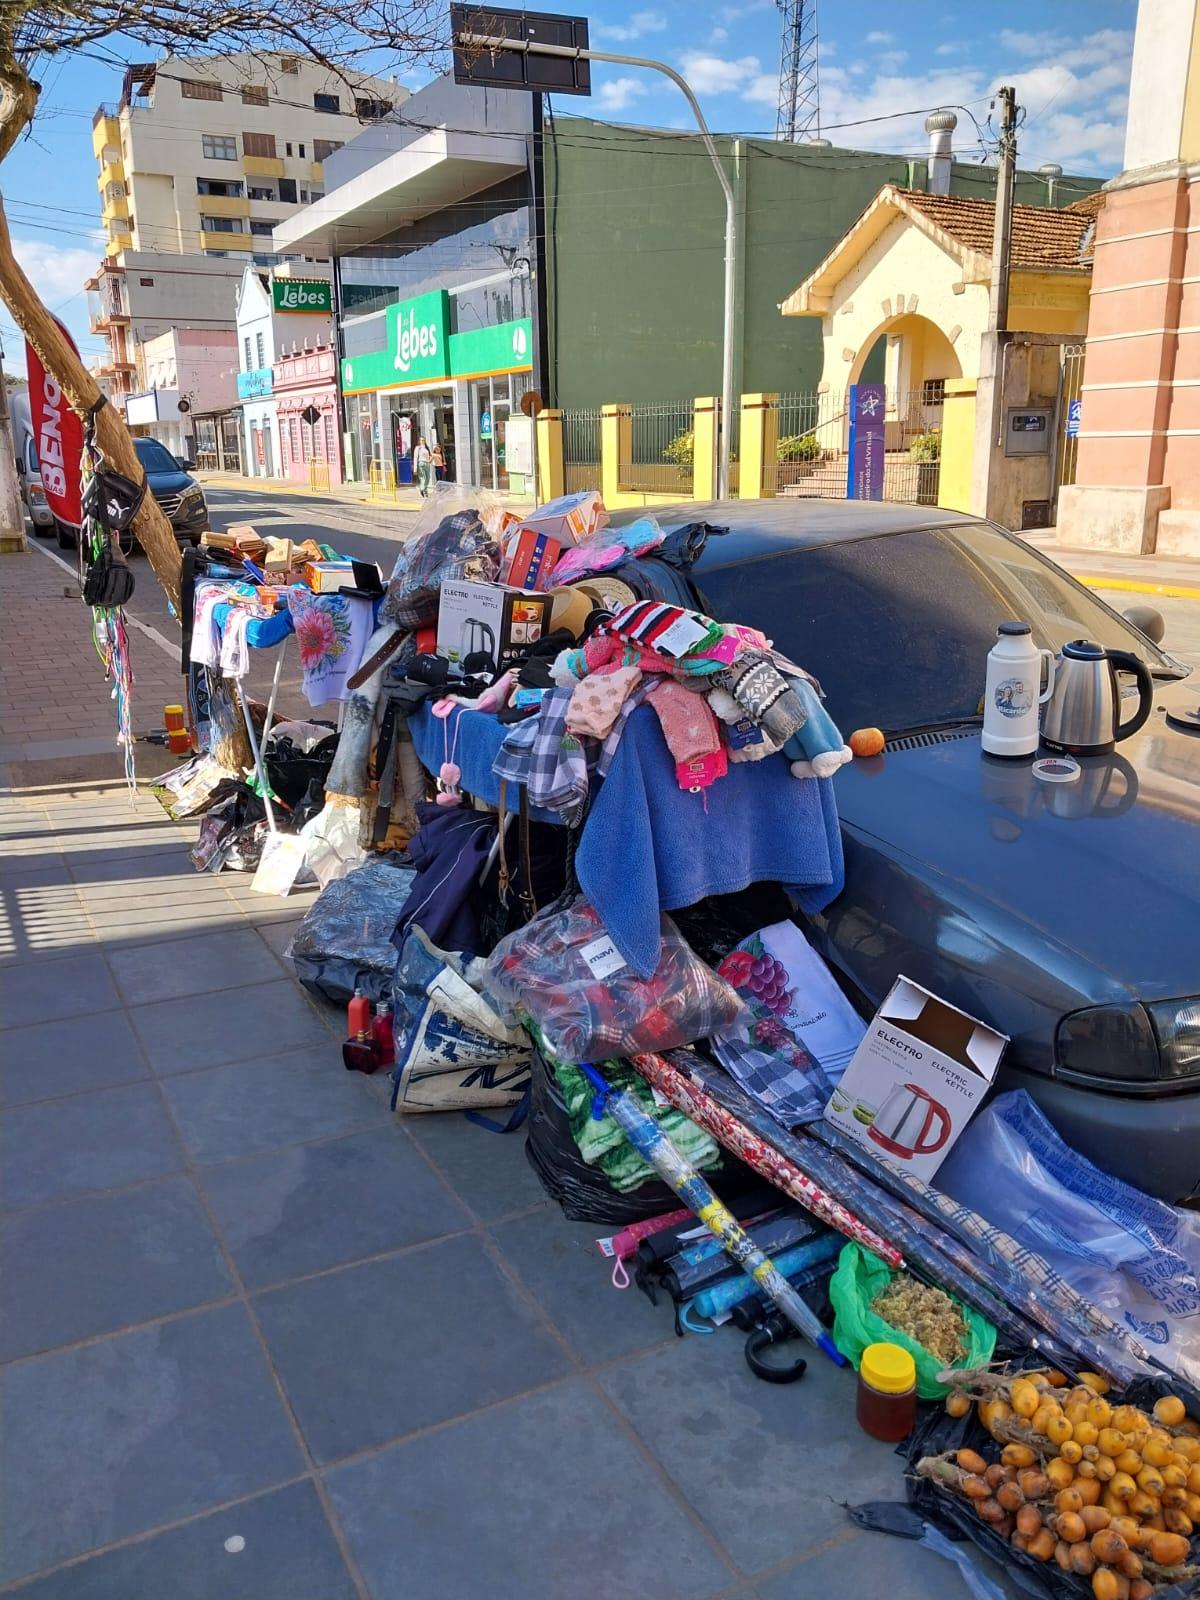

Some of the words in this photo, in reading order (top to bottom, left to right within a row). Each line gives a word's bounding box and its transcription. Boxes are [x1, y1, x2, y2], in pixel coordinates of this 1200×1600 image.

[280, 284, 325, 308] Lebes
[394, 307, 437, 372] Lebes
[444, 588, 469, 599] ELECTRO
[589, 946, 614, 964] mavi
[877, 1029, 923, 1061] ELECTRO
[931, 1061, 968, 1086] ELECTRIC
[945, 1077, 975, 1099] KETTLE
